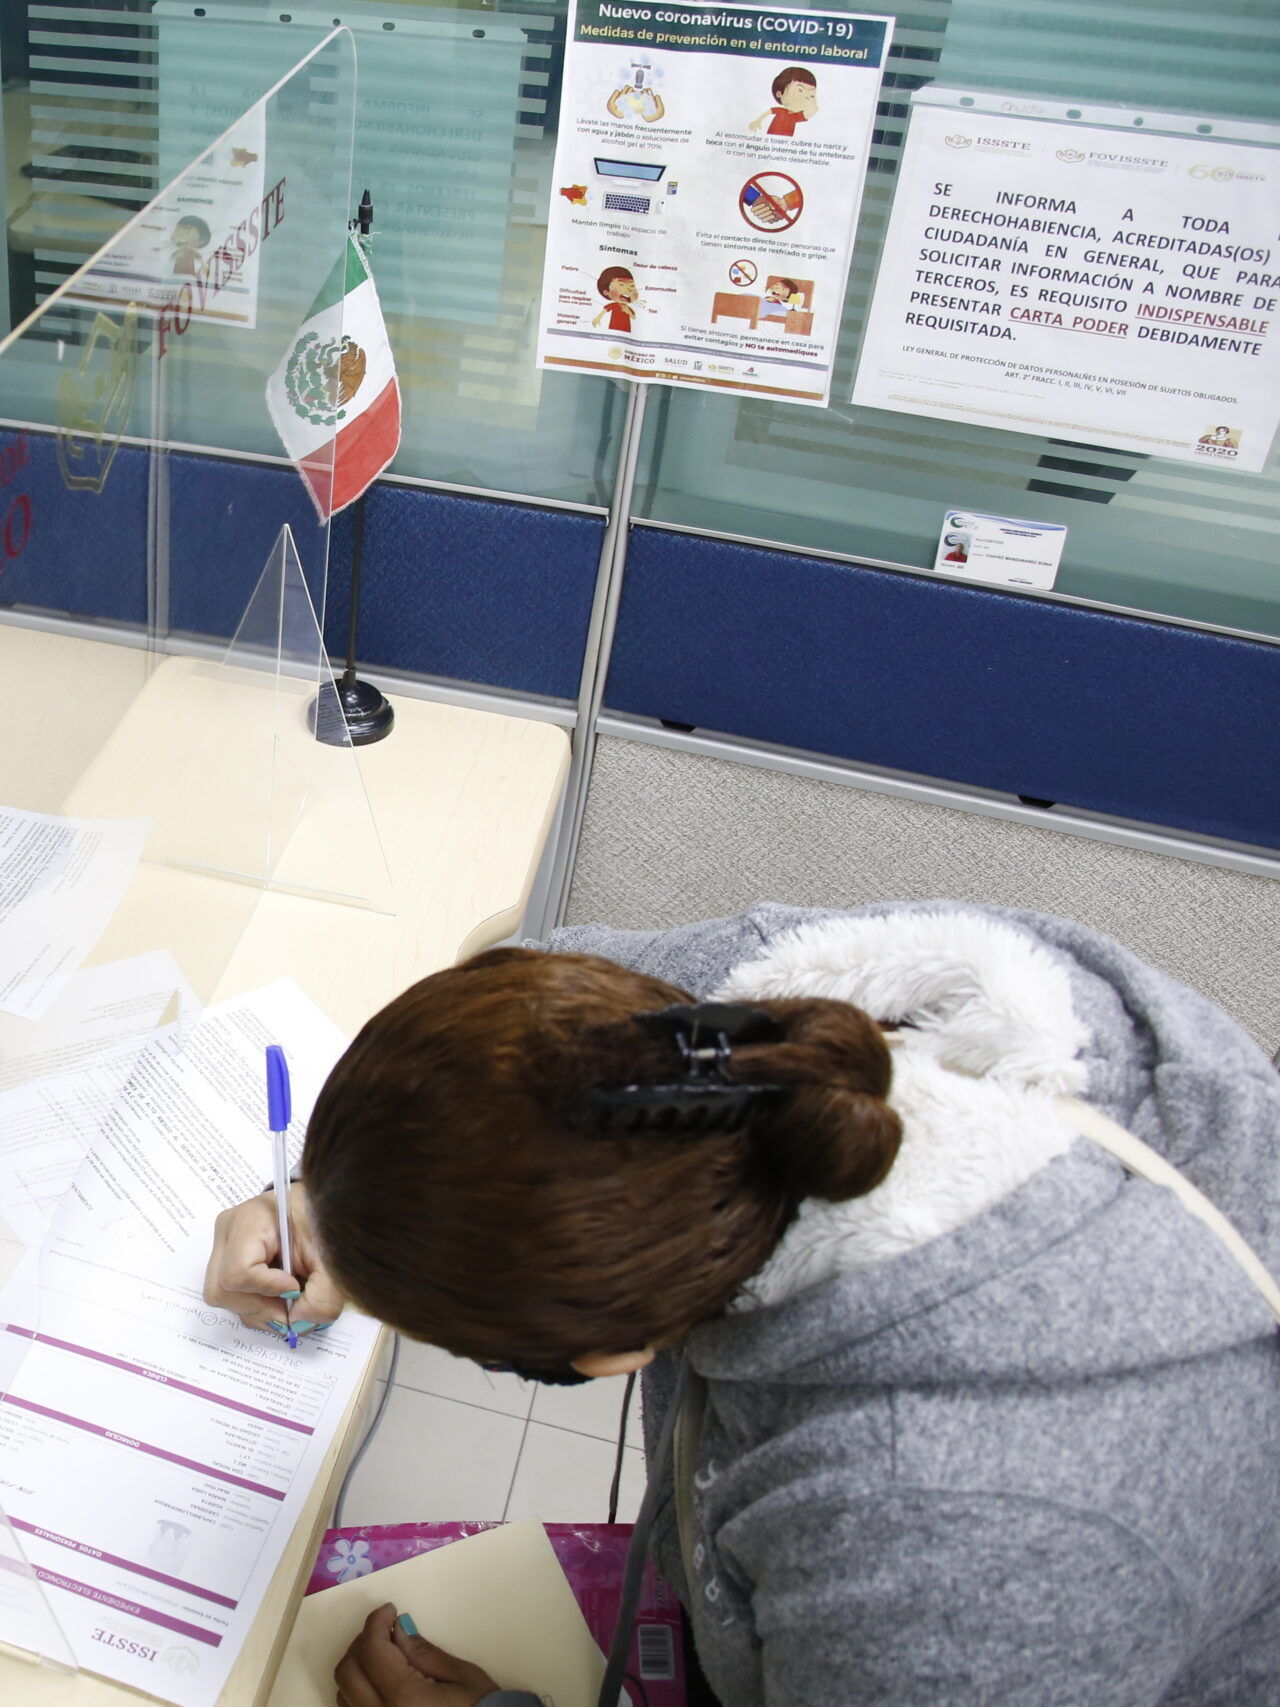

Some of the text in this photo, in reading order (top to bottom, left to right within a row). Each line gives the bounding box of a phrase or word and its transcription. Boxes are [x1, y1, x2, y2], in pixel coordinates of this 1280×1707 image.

[598, 3, 853, 40] Nuevo coronavirus (COVID-19)
[580, 24, 867, 60] Medidas de prevención en el entorno laboral
[600, 119, 609, 127] las
[610, 121, 633, 131] manos
[634, 124, 692, 135] frecuentemente
[614, 130, 635, 139] jabón
[641, 134, 678, 143] soluciones
[600, 137, 626, 146] alcohol
[627, 140, 638, 148] gel
[724, 132, 763, 142] estornudar
[791, 140, 812, 148] cubre
[823, 143, 841, 151] nariz
[745, 143, 770, 152] ángulo
[771, 146, 797, 155] interno
[818, 150, 855, 160] antebrazo
[975, 137, 1032, 151] ISSSTE
[757, 153, 787, 162] pañuelo
[1088, 151, 1169, 168] FOVISSSTE
[933, 182, 1230, 235] SE INFORMA A TODA
[571, 218, 598, 226] Mantén
[598, 220, 622, 229] limpio
[630, 226, 656, 235] espacio
[606, 230, 631, 239] trabajo
[929, 204, 1271, 266] DERECHOHABIENCIA, ACREDITADAS(OS)
[599, 244, 638, 256] Síntomas
[695, 231, 713, 239] Evita
[720, 234, 751, 243] contacto
[751, 236, 776, 246] directo
[790, 242, 821, 251] personas
[822, 246, 836, 254] que
[700, 240, 722, 248] tienen
[768, 247, 800, 257] resfriado
[808, 252, 828, 260] gripe.
[156, 177, 286, 360] FOVISSSTE
[924, 226, 1280, 289] CIUDADANÍA EN GENERAL, QUE PARA
[919, 248, 1278, 312] SOLICITAR INFORMACIÓN A NOMBRE DE
[915, 269, 1270, 334] TERCEROS, ES REQUISITO INDISPENSABLE
[905, 311, 1017, 341] REQUISITADA.
[910, 291, 1263, 356] PRESENTAR CARTA PODER DEBIDAMENTE
[684, 333, 704, 341] evitar
[705, 336, 739, 348] contagios
[766, 345, 818, 357] automediques
[687, 326, 707, 334] tienes
[740, 335, 780, 345] permanece
[791, 340, 807, 348] casa
[808, 343, 824, 351] para
[624, 353, 655, 365] MÉXICO
[664, 356, 688, 366] SALUD
[902, 344, 915, 353] LEY
[915, 347, 948, 359] GENERAL
[949, 352, 959, 360] DE
[960, 354, 1006, 368] PROTECCIÓN
[1018, 364, 1044, 373] DATOS
[1097, 376, 1109, 384] EN
[1110, 378, 1147, 390] POSESIÓN
[1148, 384, 1158, 392] DE
[1159, 386, 1192, 397] SUJETOS
[1193, 391, 1239, 405] OBLIGADOS.
[1004, 371, 1021, 380] ART.
[1032, 375, 1057, 385] FRACC.
[1195, 444, 1239, 457] 2020
[143, 1100, 157, 1115] ALTO
[155, 1114, 174, 1134] RIESGO
[171, 1133, 180, 1142] AL
[179, 1142, 200, 1165] SERVICIO
[198, 1163, 207, 1173] DE
[206, 1173, 216, 1183] LA
[103, 1429, 140, 1448] DOMICILIO
[33, 1526, 102, 1557] DATOS PERSONALES
[90, 1589, 141, 1614] EXPEDIENTE
[89, 1626, 159, 1662] ISSSTE
